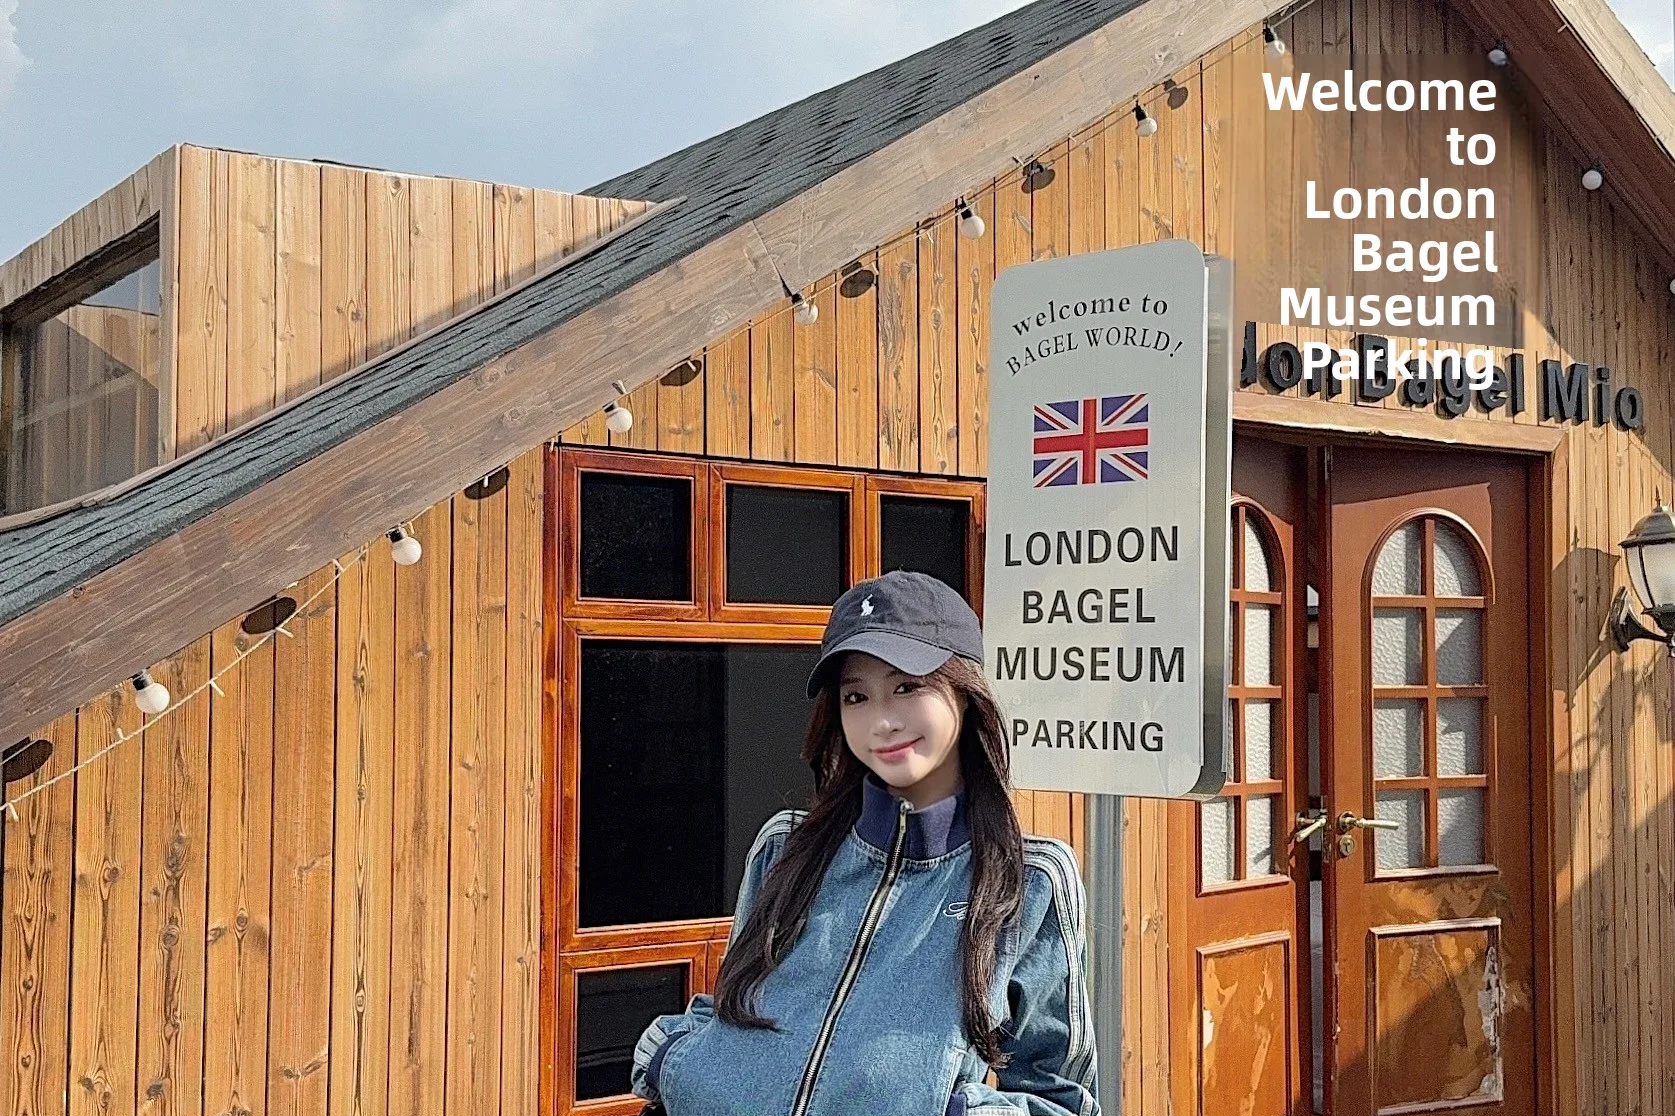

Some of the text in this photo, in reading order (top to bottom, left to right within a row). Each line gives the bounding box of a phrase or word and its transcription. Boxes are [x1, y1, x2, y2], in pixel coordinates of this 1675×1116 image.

[1012, 293, 1168, 337] welcome to
[1005, 326, 1184, 376] BAGEL WORLD!
[1005, 526, 1177, 566] LONDON
[1023, 588, 1155, 623] BAGEL
[997, 647, 1184, 682] MUSEUM
[1013, 719, 1163, 751] PARKING
